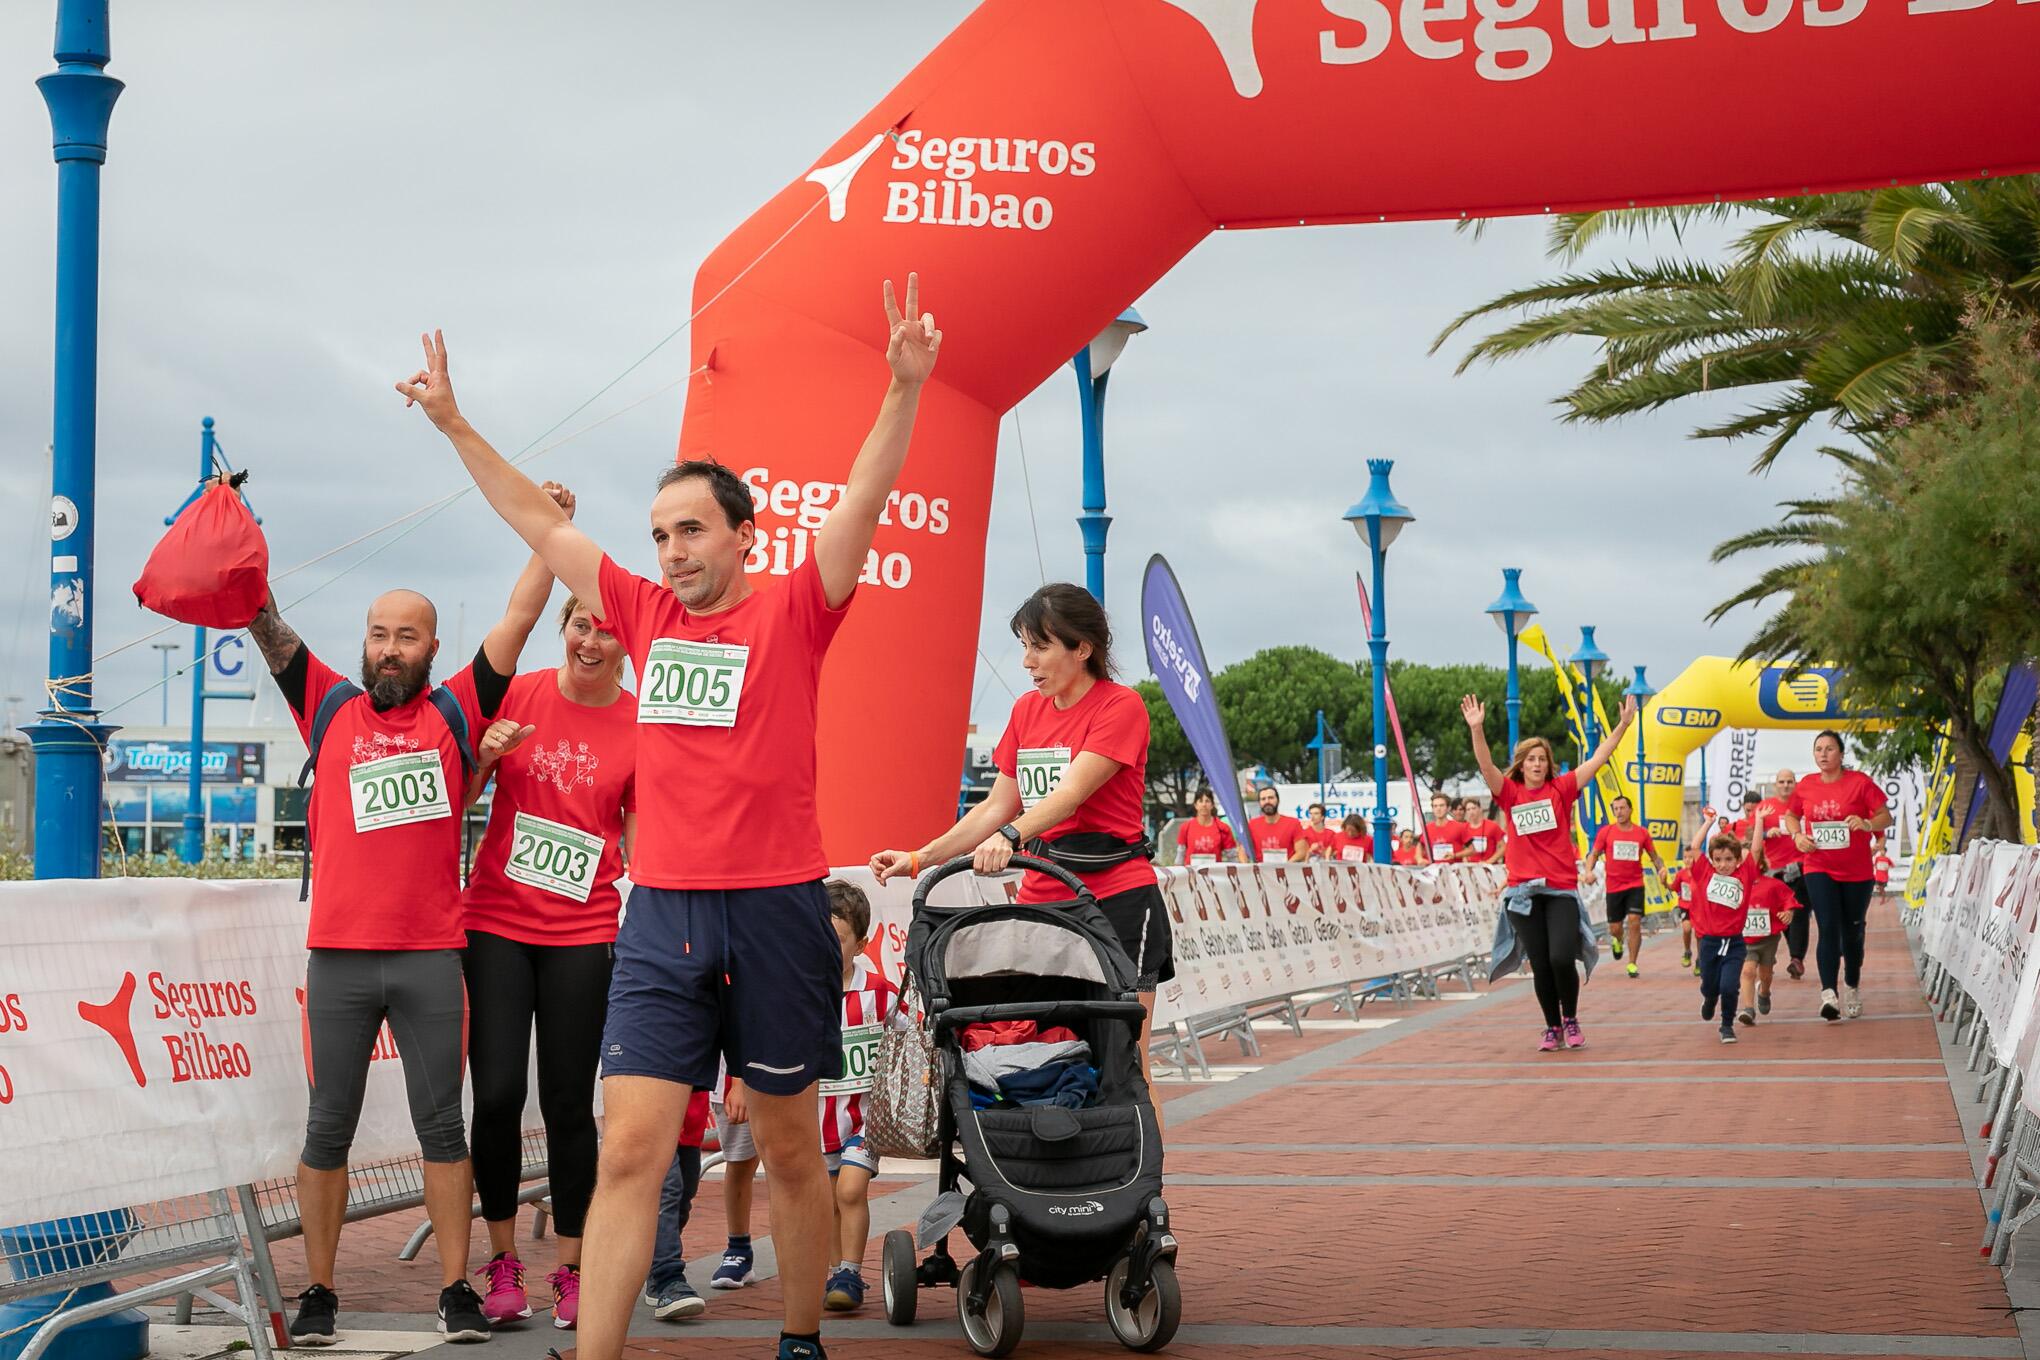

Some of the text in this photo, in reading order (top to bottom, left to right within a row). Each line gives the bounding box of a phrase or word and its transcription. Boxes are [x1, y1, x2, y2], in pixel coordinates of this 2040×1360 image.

[891, 129, 1096, 180] Seguros
[882, 179, 1053, 231] Bilbao
[741, 467, 950, 535] Segros
[743, 526, 912, 590] Bilao
[213, 635, 244, 676] C
[649, 662, 733, 707] 2005
[1685, 709, 1718, 726] BM
[1018, 766, 1062, 797] 005
[1650, 764, 1682, 783] BM
[1727, 729, 1744, 813] CORRE
[362, 771, 438, 814] 2003
[1517, 808, 1550, 828] 2050
[1648, 821, 1677, 838] BM
[1816, 829, 1846, 843] 2043
[513, 834, 589, 882] 2003
[1711, 882, 1741, 903] 2050
[147, 971, 257, 1029] Seguros
[161, 1031, 251, 1083] Bilbao
[842, 1042, 879, 1080] 05
[1048, 1205, 1067, 1215] city
[1069, 1204, 1092, 1213] mini
